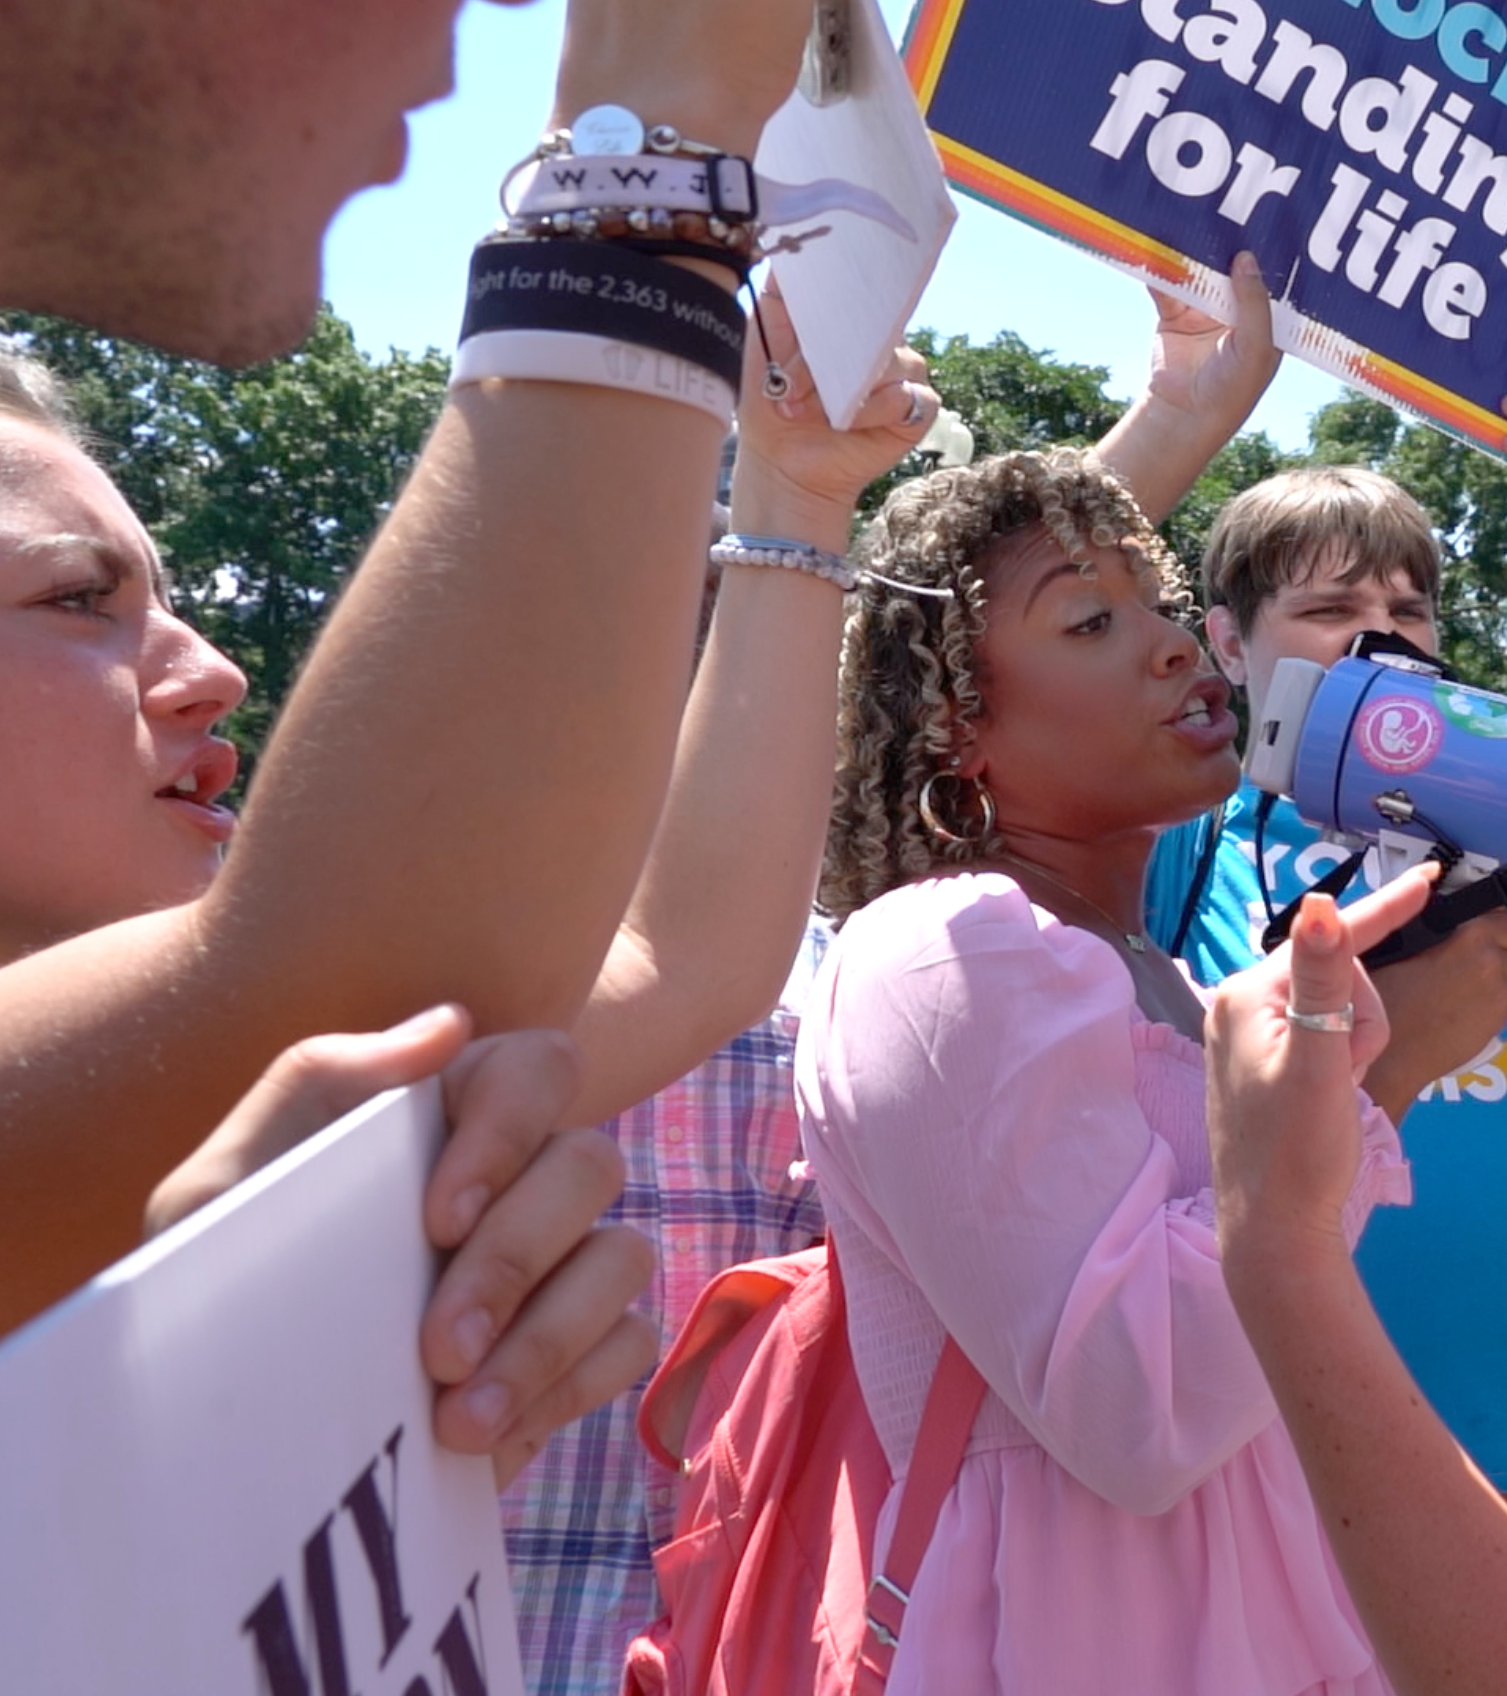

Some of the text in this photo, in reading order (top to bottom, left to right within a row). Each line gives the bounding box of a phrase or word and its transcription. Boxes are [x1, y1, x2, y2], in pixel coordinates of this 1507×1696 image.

[1089, 59, 1487, 340] for life
[509, 266, 541, 289] for
[550, 269, 593, 295] the
[598, 275, 668, 312] 2,363
[654, 353, 717, 403] LIFE
